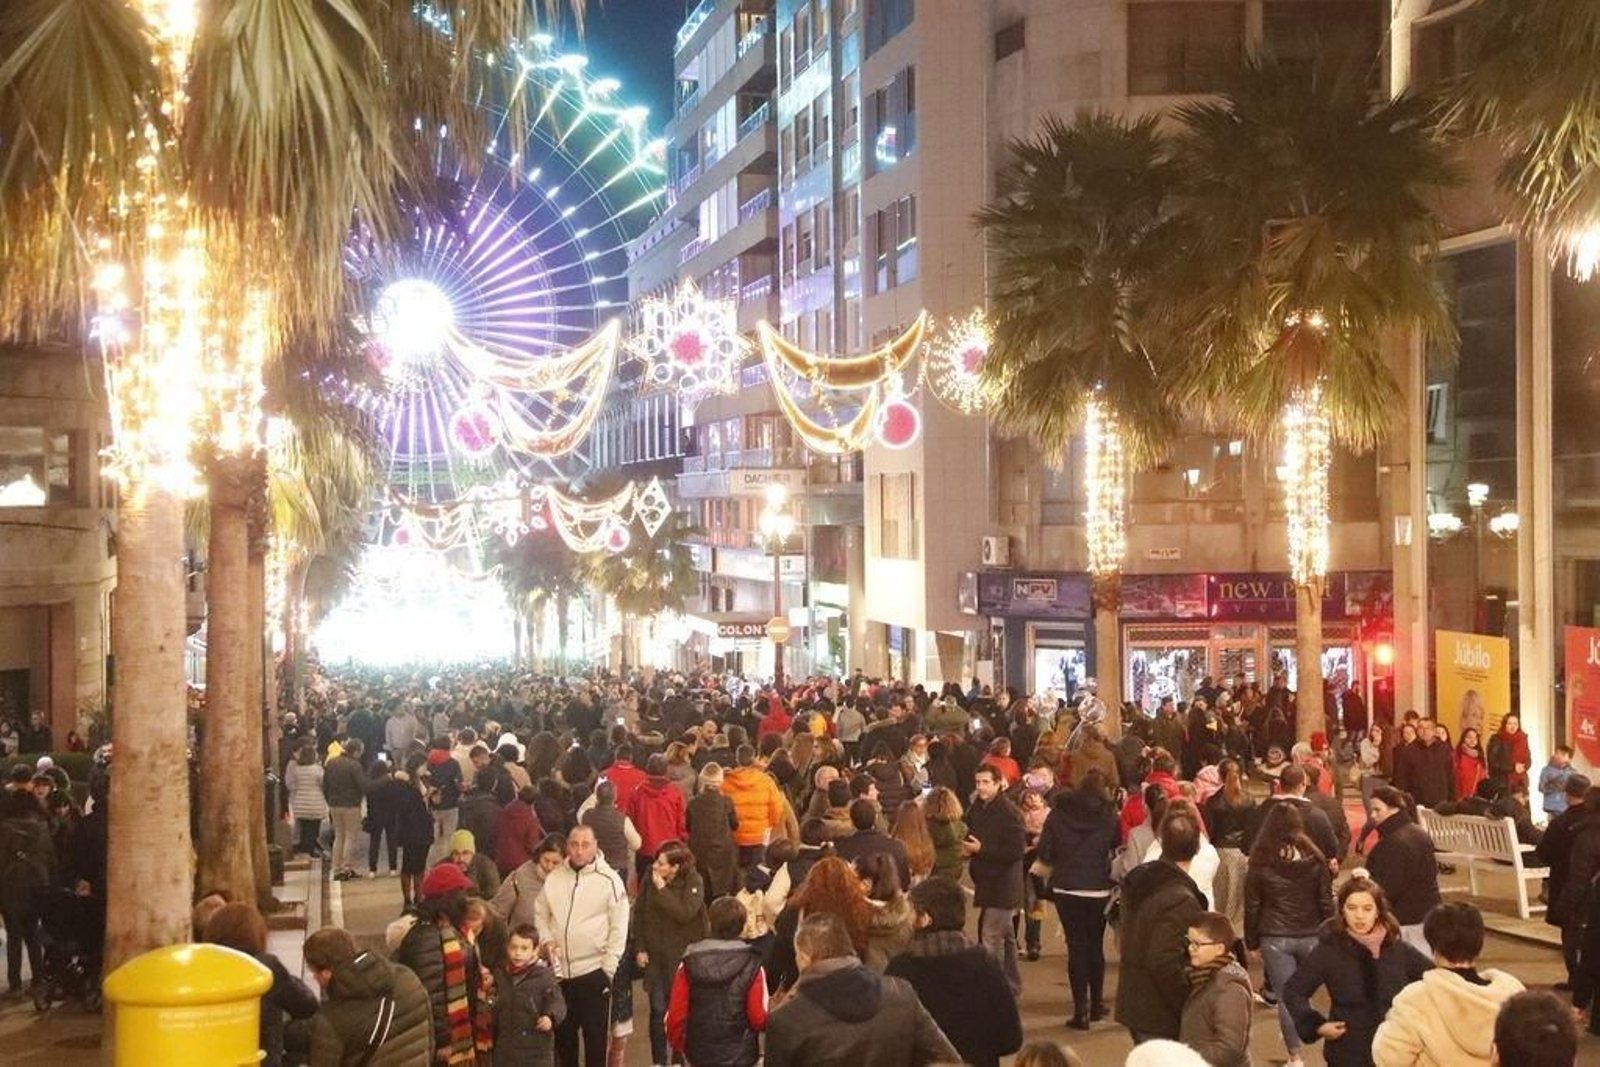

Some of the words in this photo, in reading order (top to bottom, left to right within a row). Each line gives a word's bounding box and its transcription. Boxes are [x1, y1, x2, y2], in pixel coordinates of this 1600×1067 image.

[1016, 583, 1051, 595] NPV
[1220, 581, 1272, 599] new
[718, 624, 762, 636] COLON
[1454, 639, 1491, 669] Júbilo
